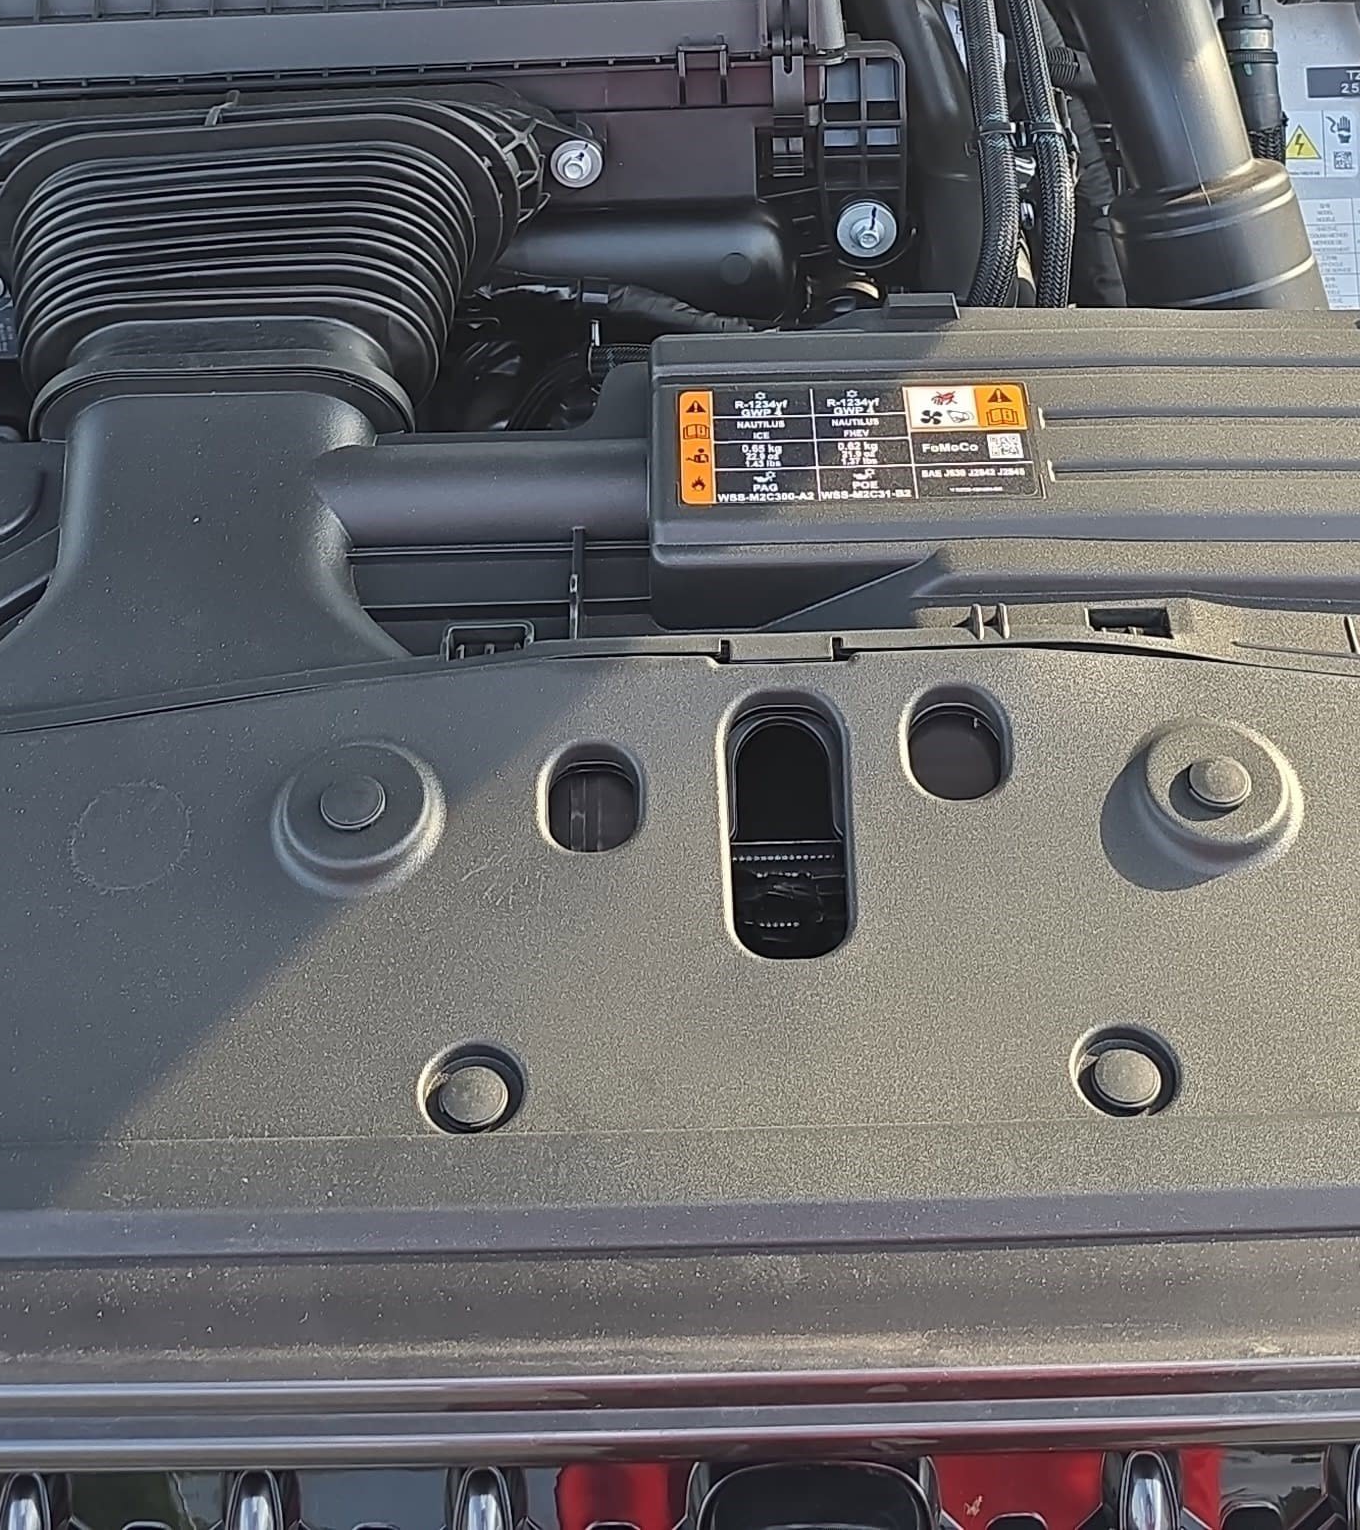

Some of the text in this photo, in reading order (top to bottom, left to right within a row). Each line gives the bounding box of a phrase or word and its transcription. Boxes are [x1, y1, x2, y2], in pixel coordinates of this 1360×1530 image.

[734, 399, 788, 411] R-1234yf
[826, 397, 880, 409] R-1234yf
[741, 408, 771, 417] GWP
[833, 406, 864, 414] GWP
[736, 420, 785, 429] NAUTILUS
[831, 418, 879, 426] NAUTILUS
[753, 431, 770, 439] ICE
[741, 444, 782, 455] 0.65 kg
[863, 442, 878, 452] kg
[922, 442, 979, 453] FoMoCo
[752, 484, 779, 492] PAG
[852, 481, 879, 489] POE
